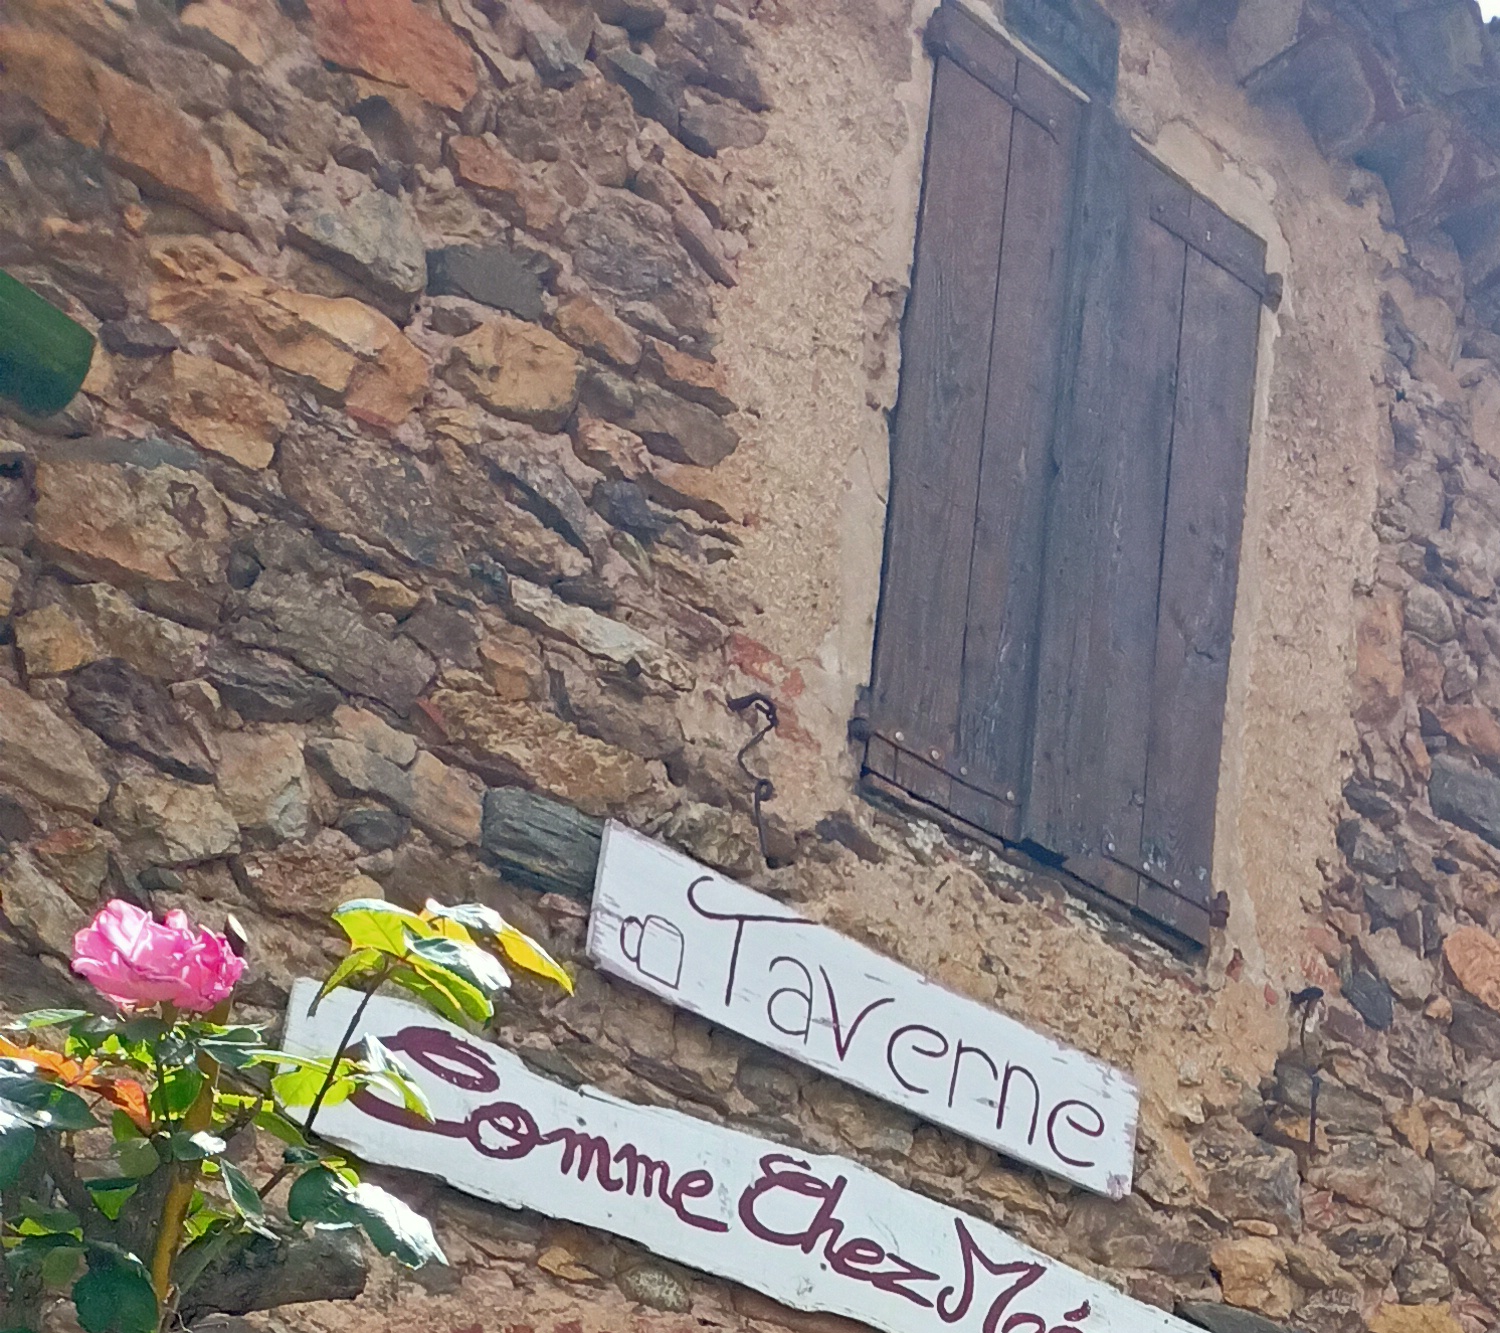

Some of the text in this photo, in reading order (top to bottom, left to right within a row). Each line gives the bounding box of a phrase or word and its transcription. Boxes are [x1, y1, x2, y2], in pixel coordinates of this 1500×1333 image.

[688, 873, 1105, 1168] Taverne
[341, 1025, 729, 1233] Comme
[738, 1153, 941, 1309] Chez
